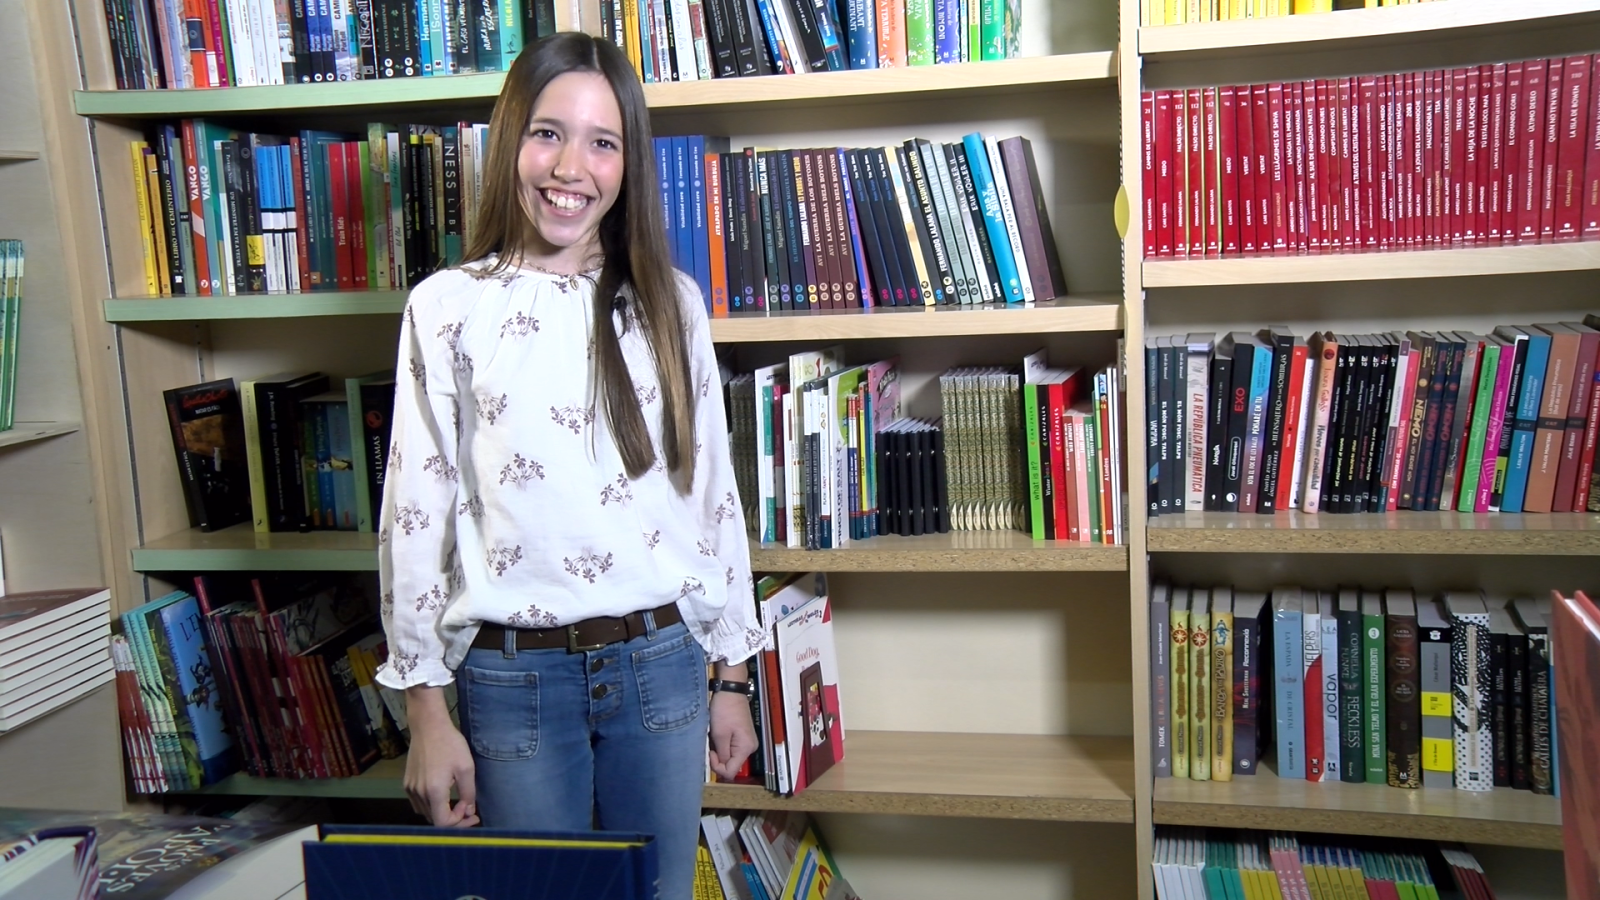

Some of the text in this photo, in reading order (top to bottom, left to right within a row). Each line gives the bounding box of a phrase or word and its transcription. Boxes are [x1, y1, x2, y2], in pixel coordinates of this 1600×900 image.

[1571, 85, 1580, 107] BOWEN
[1528, 90, 1537, 132] ÚLTIMO DESEO
[1273, 130, 1279, 138] DE
[1469, 129, 1475, 137] DE
[1570, 118, 1578, 129] ISLA
[1570, 130, 1577, 138] LA
[1146, 143, 1152, 151] DE
[1468, 153, 1474, 161] LA
[444, 146, 457, 189] NESS
[793, 157, 801, 171] MEDIO
[804, 155, 814, 186] BOTONES
[817, 155, 826, 182] BOTONS
[909, 151, 923, 178] GALINDO
[188, 165, 199, 200] VANGO
[200, 165, 210, 200] VANGO
[758, 158, 769, 194] NUNCA MÁS
[796, 177, 804, 195] PERROS
[951, 167, 964, 194] VOGLER
[961, 165, 974, 192] VOGLER
[165, 180, 176, 225] CEMENTERIO
[714, 196, 720, 204] EN
[808, 187, 816, 200] LOS
[820, 184, 828, 201] DELS
[916, 180, 930, 204] ASUNTO
[967, 194, 978, 211] ERIK
[988, 182, 1003, 222] la Sibila
[799, 202, 807, 220] LALANA
[810, 202, 817, 211] DE
[958, 196, 969, 212] ERIK
[982, 198, 994, 217] Ana
[811, 213, 821, 241] GUERRA
[822, 203, 831, 230] GUERRA
[925, 214, 939, 237] LALANA
[337, 217, 346, 245] Train Kids
[801, 221, 810, 245] FERNANDO
[826, 232, 832, 242] LA
[171, 238, 179, 258] LIBRO
[815, 243, 822, 252] LA
[932, 238, 948, 271] FERNANDO
[1193, 393, 1204, 402] LA
[1234, 387, 1245, 412] EXO
[1319, 368, 1332, 412] Laura Gallego
[1193, 405, 1203, 444] REPÚBLICA
[1412, 399, 1425, 437] NEMO
[1568, 432, 1576, 447] BERRY
[373, 436, 383, 484] EN LLAMAS
[1030, 461, 1038, 470] it?
[1032, 482, 1040, 500] what
[1285, 632, 1292, 640] LA
[796, 647, 820, 663] Good Dog,
[1341, 648, 1349, 678] FUNKE
[1350, 633, 1358, 678] CORNELIA
[1370, 648, 1379, 683] EXPERIMENTO
[1287, 691, 1293, 700] DE
[1323, 673, 1338, 720] vapor
[1371, 684, 1379, 699] GRAN
[1347, 696, 1361, 748] RECKLESS
[1371, 714, 1380, 731] TELMO
[1538, 671, 1550, 768] CALLES DE CHATARRA
[1372, 732, 1380, 744] SAN
[1372, 745, 1380, 758] MINA
